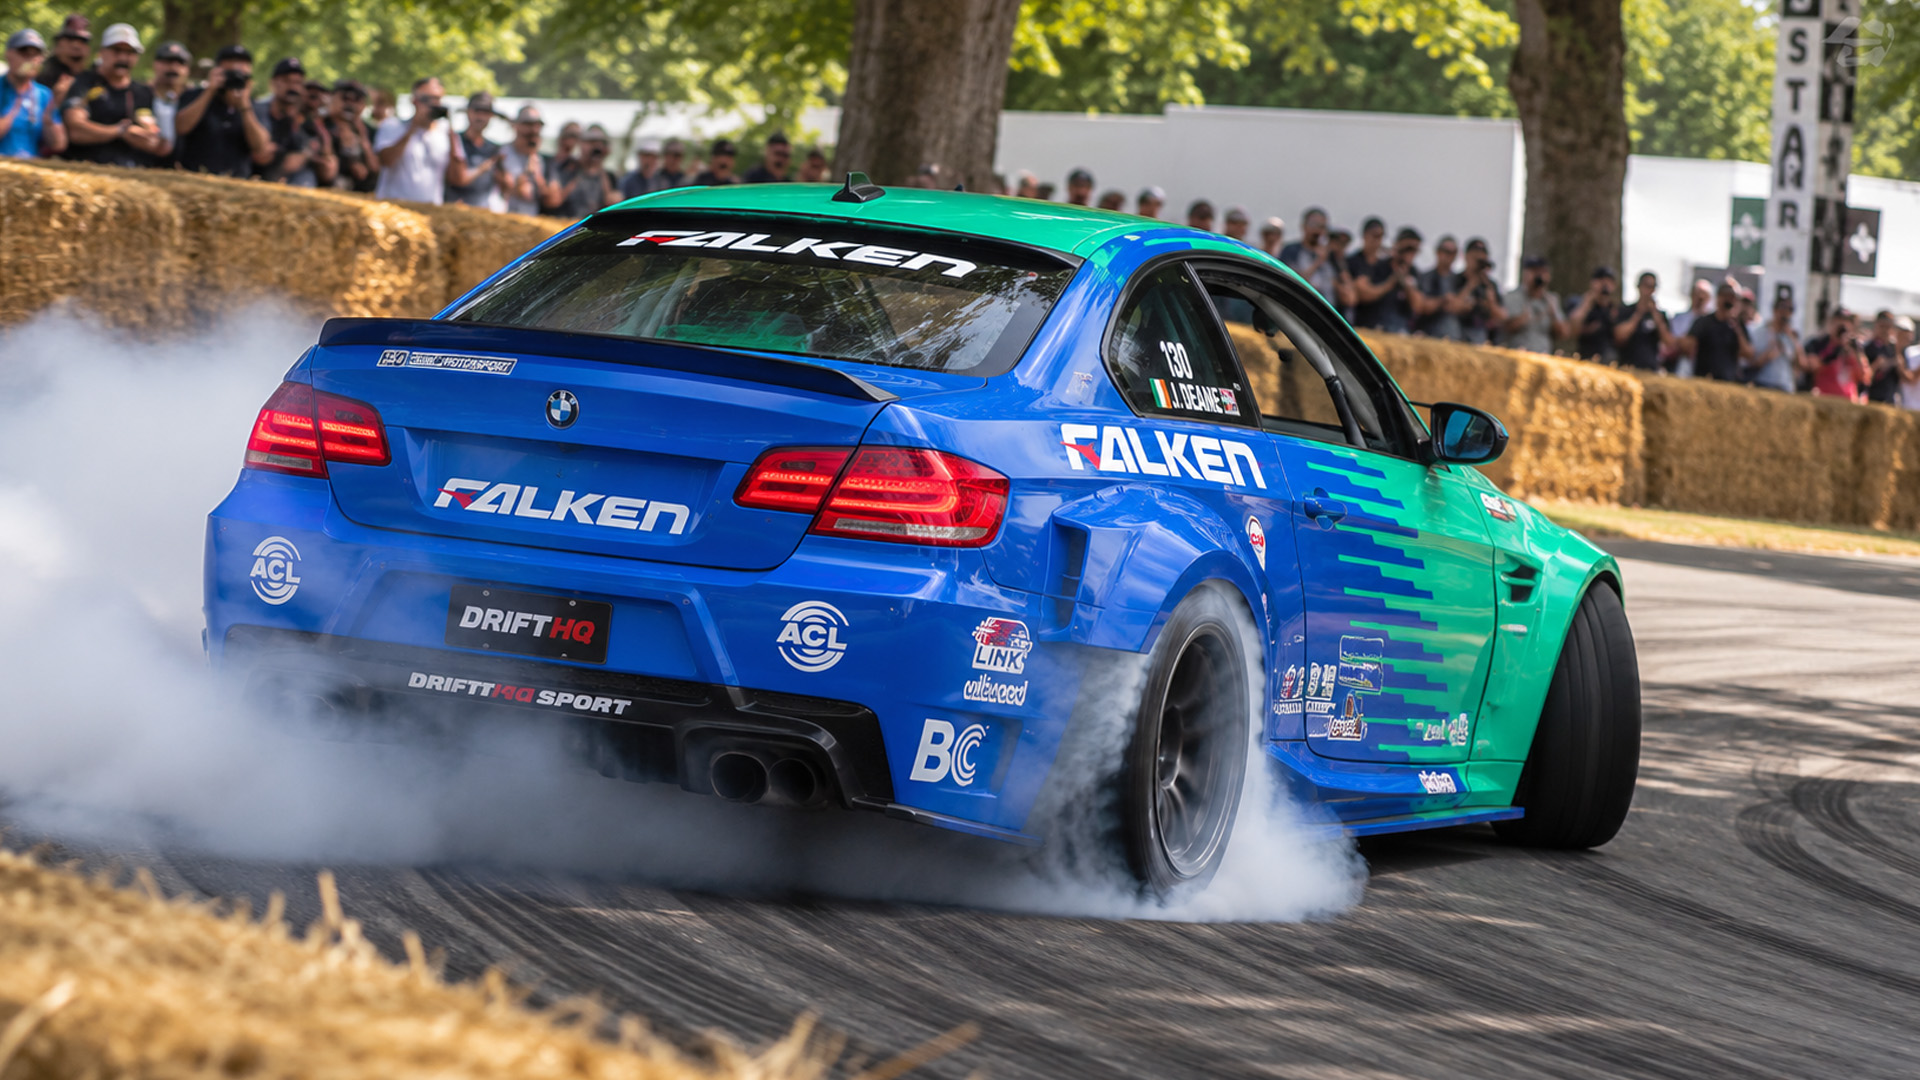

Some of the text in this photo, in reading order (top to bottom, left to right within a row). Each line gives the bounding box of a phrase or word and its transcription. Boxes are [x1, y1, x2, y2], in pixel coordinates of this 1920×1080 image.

[616, 230, 977, 278] FALKEN
[1160, 340, 1193, 379] 130
[1060, 423, 1267, 489] FALKEN
[434, 478, 690, 535] FALKEN
[249, 557, 301, 584] ACL
[776, 622, 848, 651] ACL
[975, 645, 1023, 670] LINK
[536, 690, 632, 715] SPORT
